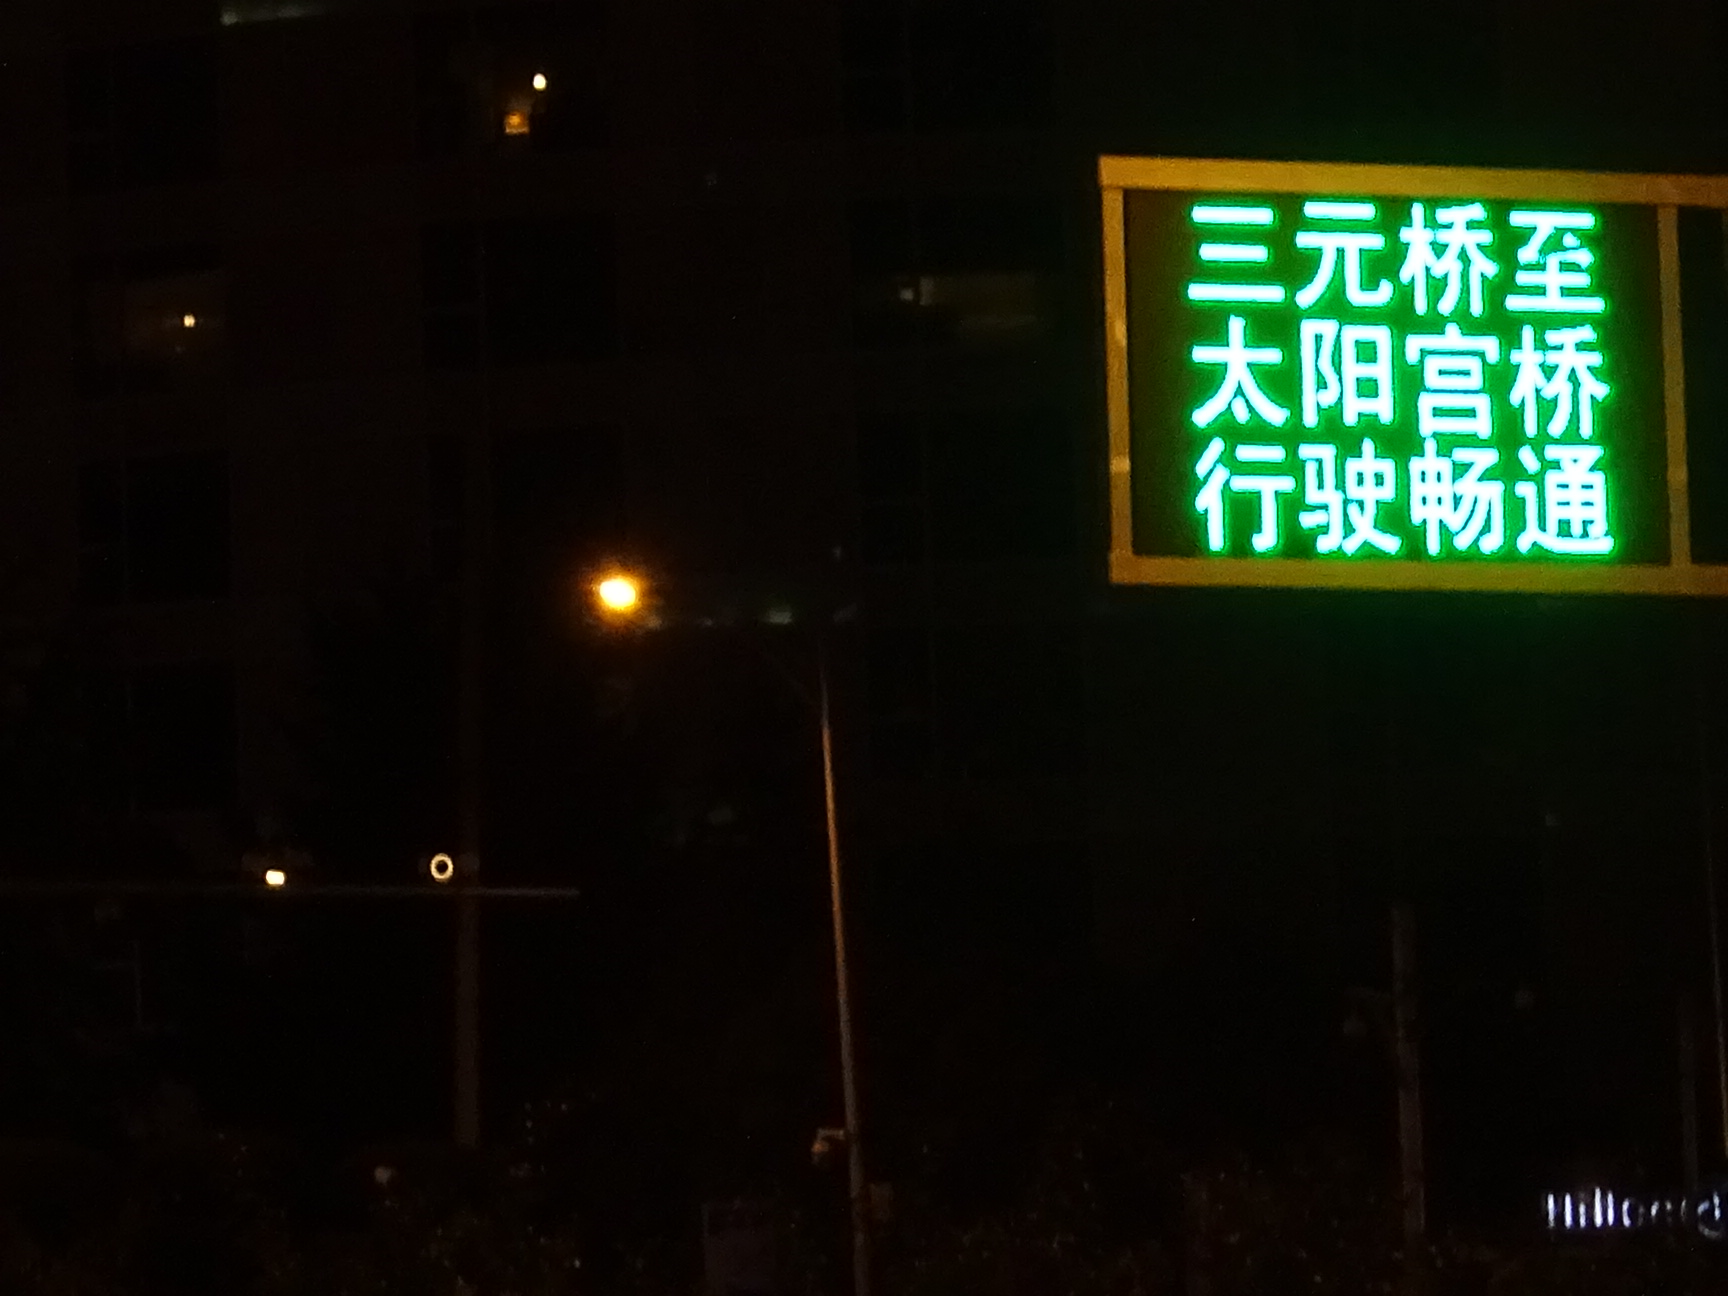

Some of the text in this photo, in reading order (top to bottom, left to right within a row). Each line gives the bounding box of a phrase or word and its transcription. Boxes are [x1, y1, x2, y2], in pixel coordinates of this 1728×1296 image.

[1187, 201, 1606, 316] 三元桥至
[1190, 316, 1611, 438] 太阳宫桥
[1194, 438, 1616, 557] 行驶畅通
